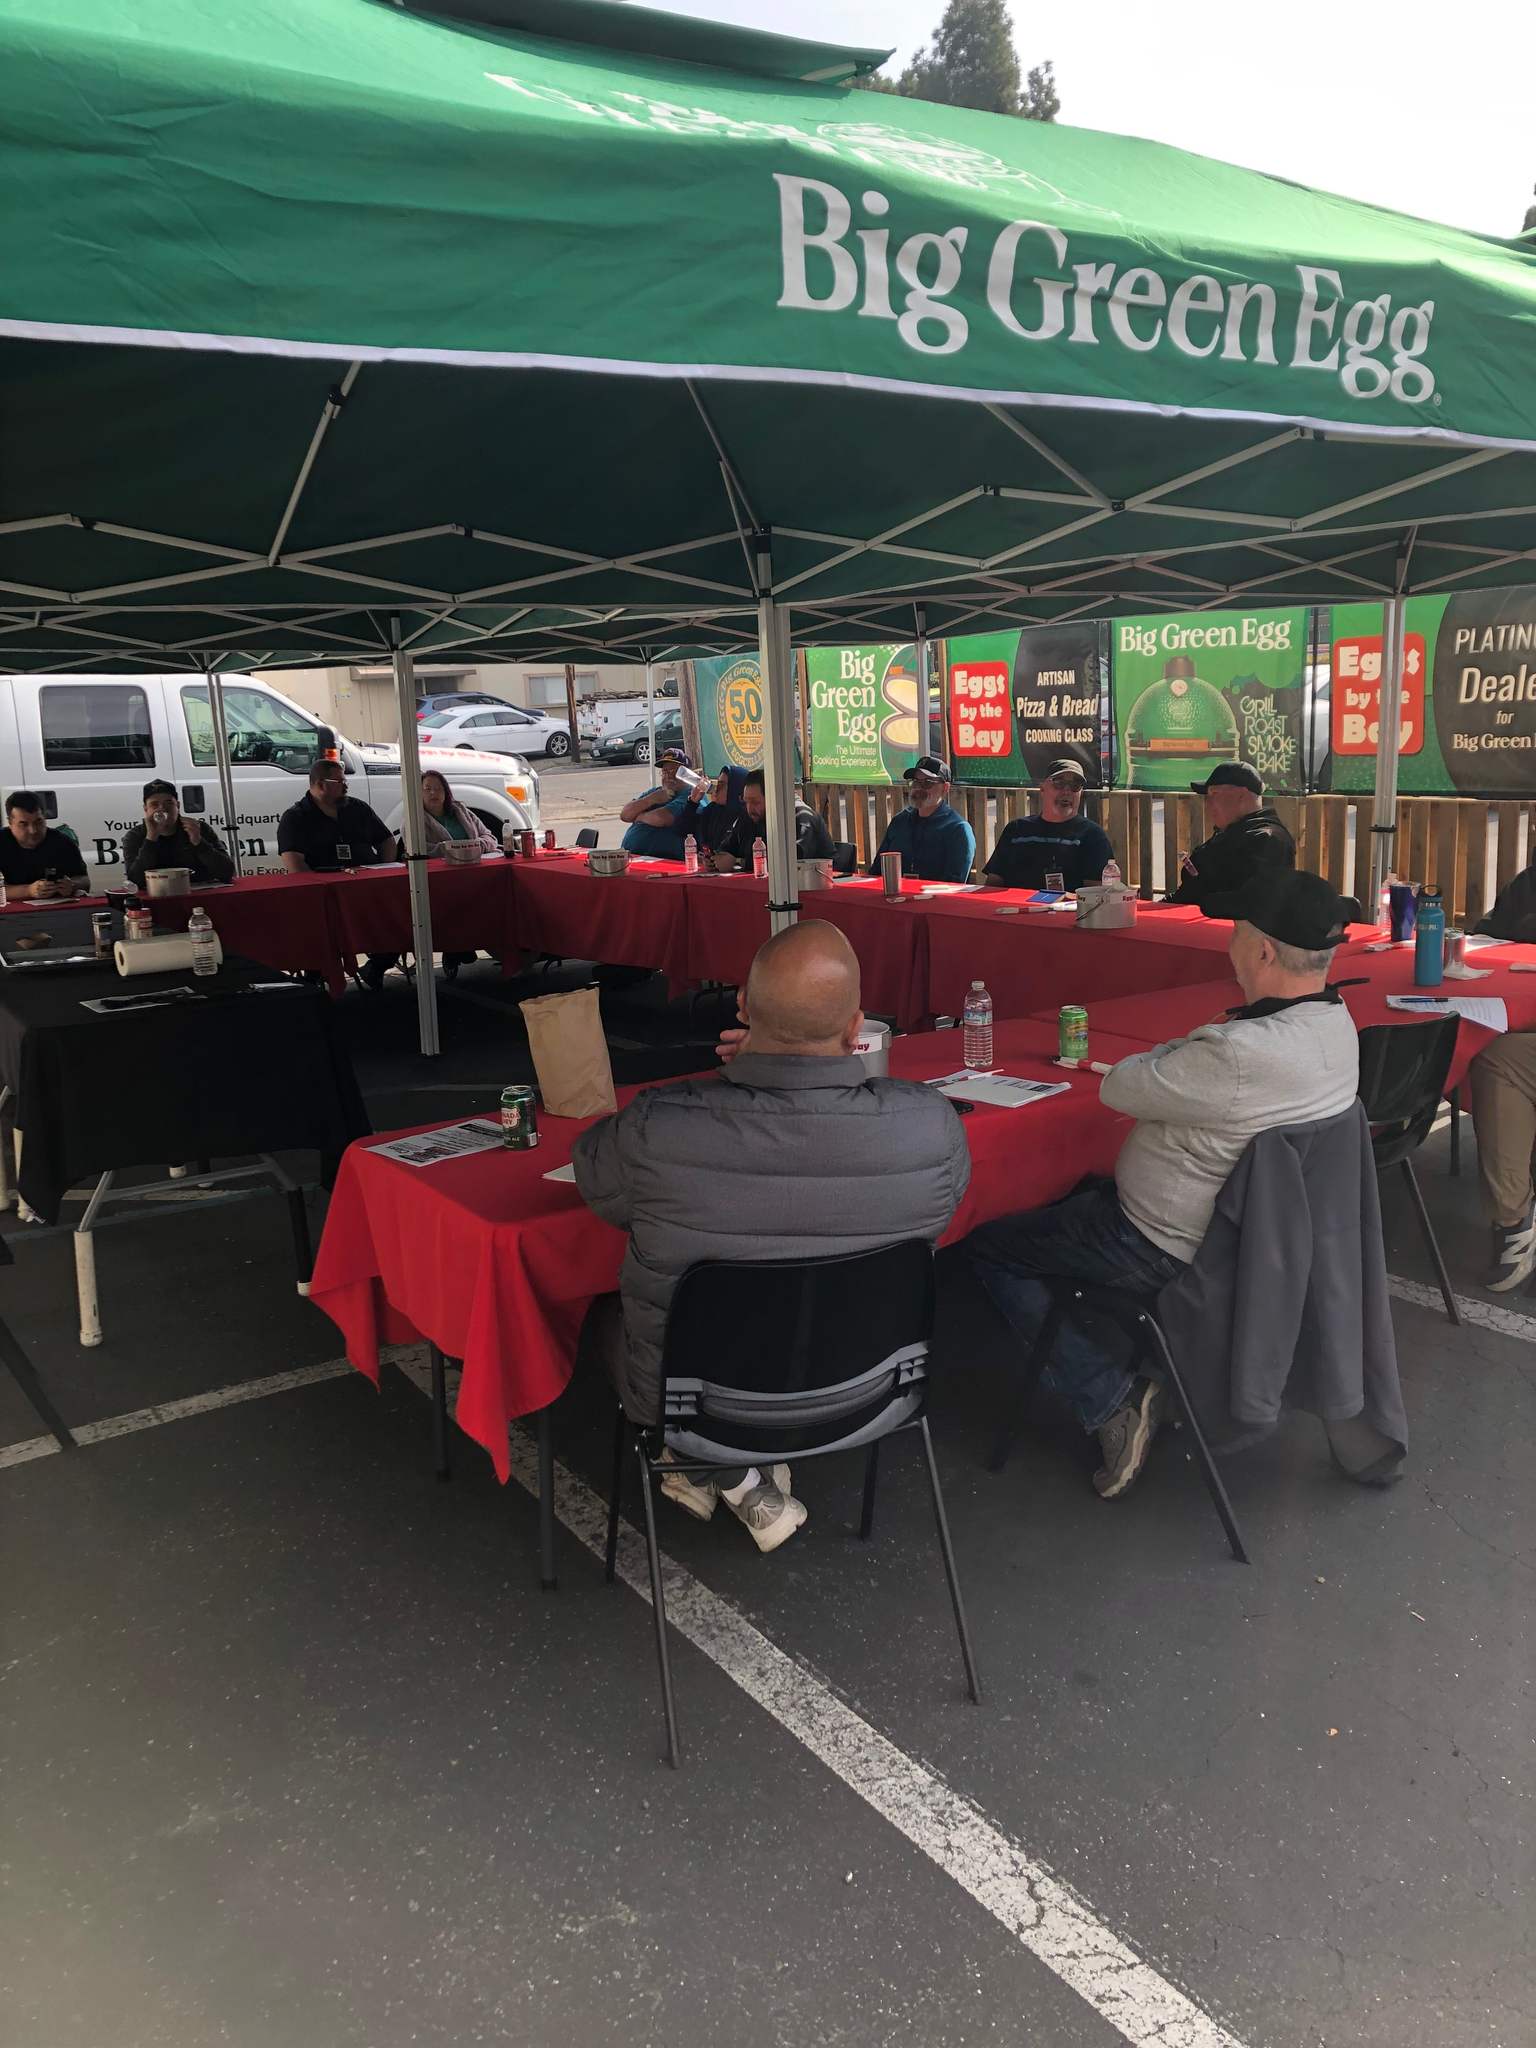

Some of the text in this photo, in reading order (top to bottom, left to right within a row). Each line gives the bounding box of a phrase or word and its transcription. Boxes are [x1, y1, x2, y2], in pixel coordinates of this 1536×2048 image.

[773, 173, 1435, 403] Big Green Egg
[1120, 618, 1292, 656] Big Green Egg
[840, 650, 876, 685] Big
[1339, 645, 1421, 681] Egs
[954, 671, 1005, 698] Eggs
[1037, 670, 1075, 686] ARTISAN
[812, 680, 876, 708] Green
[1345, 688, 1371, 709] by
[729, 688, 762, 723] 50
[960, 703, 1003, 721] by the
[1017, 694, 1099, 718] Pizza & Bread
[1240, 694, 1277, 717] GRILL
[837, 709, 878, 744] Egg
[1245, 715, 1288, 736] ROAST
[1496, 710, 1514, 724] for
[733, 724, 762, 735] YEARS
[958, 724, 1004, 753] Bay
[1026, 728, 1093, 743] COOKING CLASS
[836, 744, 876, 756] The Ultimate
[1248, 734, 1296, 755] SMOKE
[1452, 733, 1478, 751] Big
[1480, 732, 1531, 749] Green
[812, 755, 877, 767] Cooking Experience
[1257, 751, 1291, 774] BAKE
[104, 820, 138, 831] Your
[209, 813, 280, 827] Hedquart
